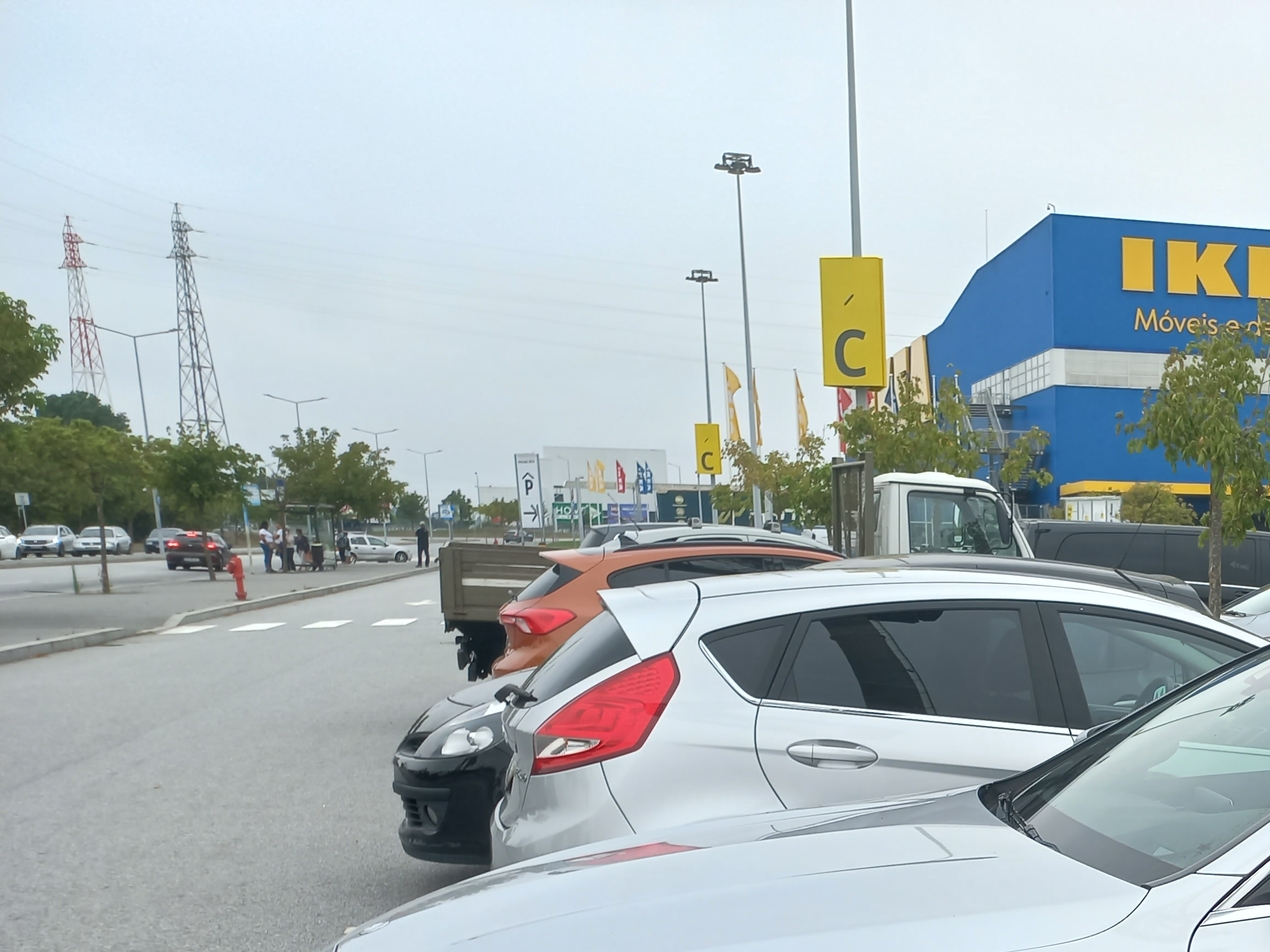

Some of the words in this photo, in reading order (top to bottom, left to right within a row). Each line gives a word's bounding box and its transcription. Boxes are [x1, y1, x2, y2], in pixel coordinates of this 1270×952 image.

[1134, 307, 1218, 335] Móveis
[1225, 319, 1240, 336] e
[834, 328, 866, 378] C
[701, 451, 714, 472] C
